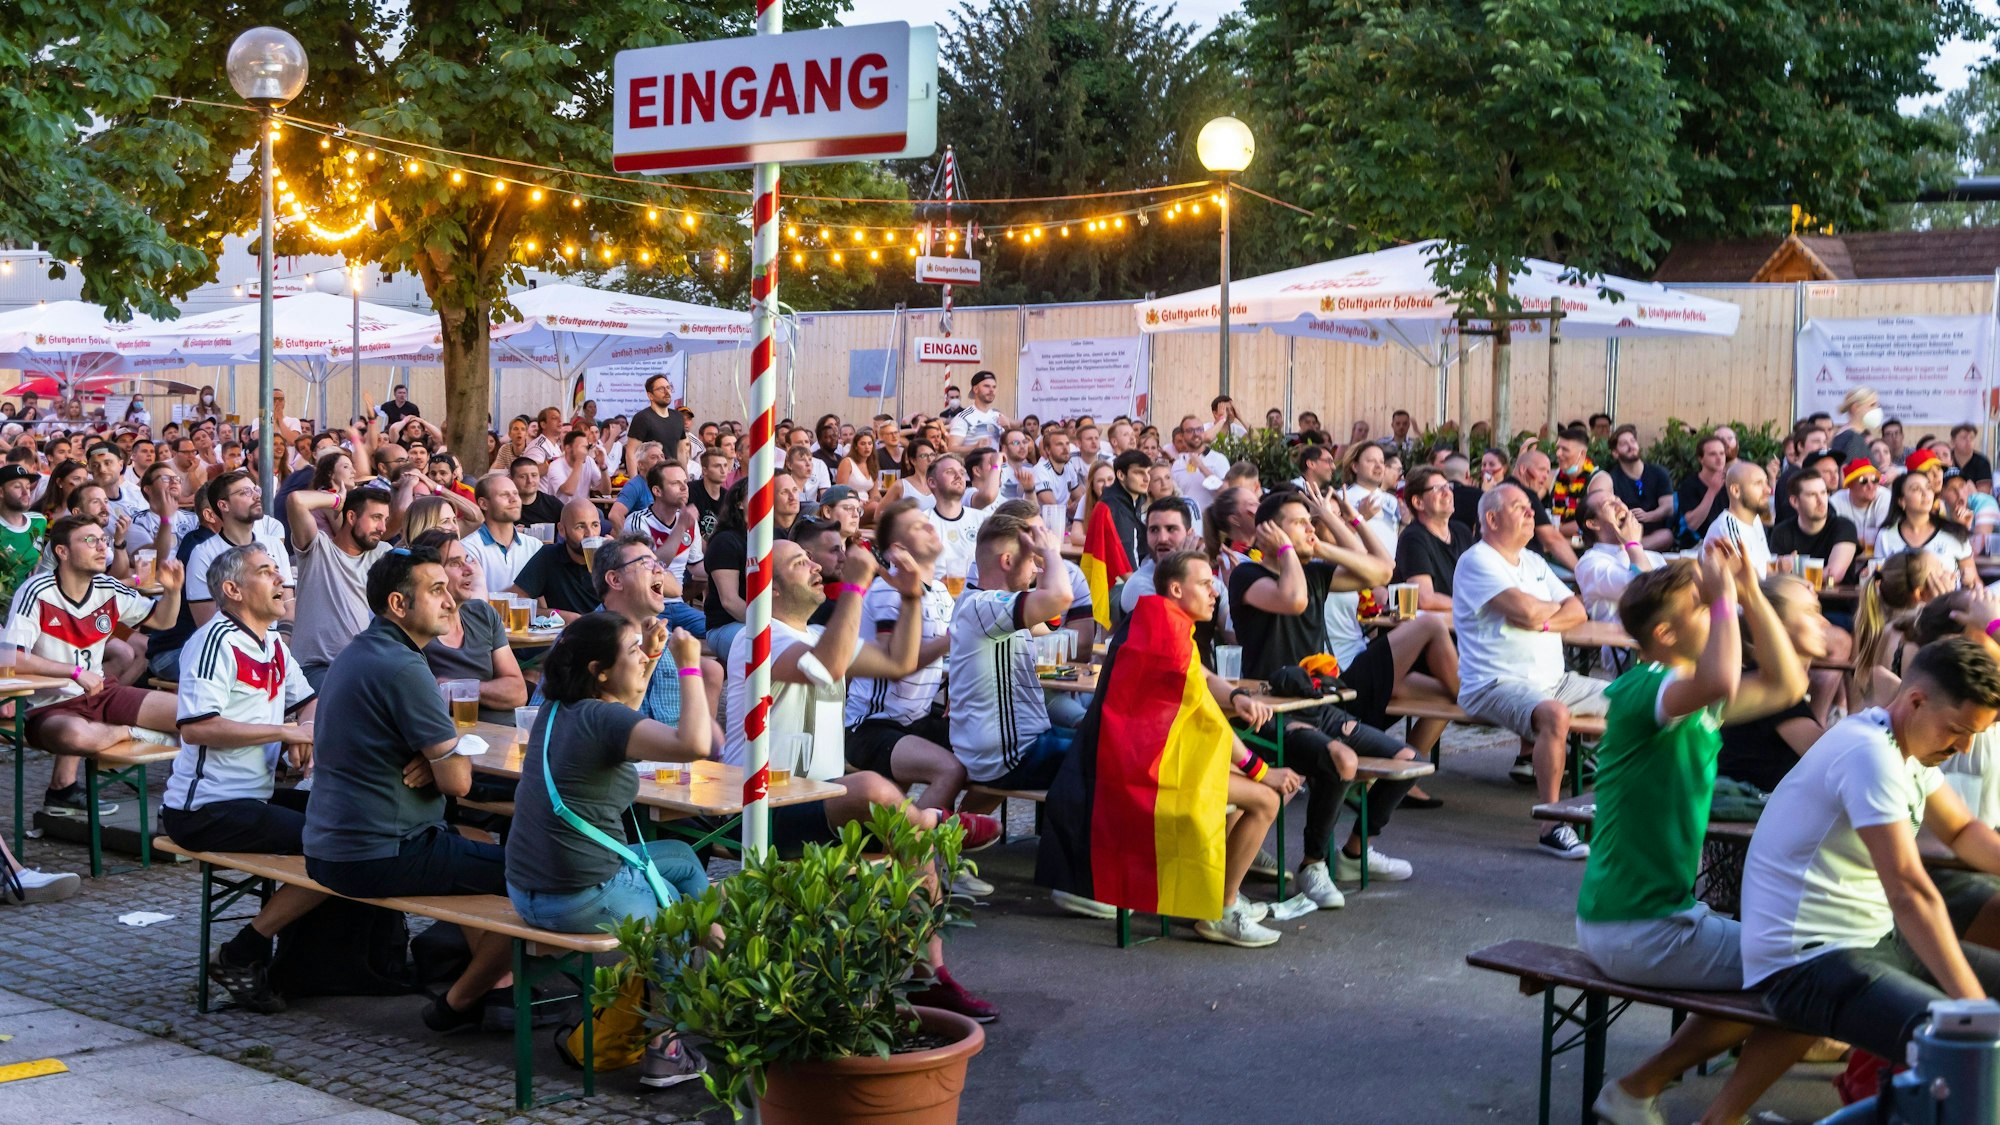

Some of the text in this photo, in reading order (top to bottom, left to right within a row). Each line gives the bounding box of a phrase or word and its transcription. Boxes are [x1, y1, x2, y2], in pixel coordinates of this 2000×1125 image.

[629, 53, 888, 129] EINGANG
[934, 264, 958, 274] Stuttgarter
[1338, 295, 1433, 312] Stuttgarter Hofbräu
[1522, 296, 1550, 312] Stuttgar
[1161, 302, 1247, 322] Stuttgarter Horäu
[1648, 306, 1706, 322] Stuttgarter Hofbräu
[558, 316, 628, 329] Stuttgarter Hofbräu
[692, 324, 726, 334] Stuttgarter
[48, 336, 87, 346] Stuttgarter
[286, 338, 326, 349] Stuttgarter
[340, 346, 368, 354] Stuttrter
[924, 343, 978, 355] EINGANG
[74, 649, 92, 670] 13
